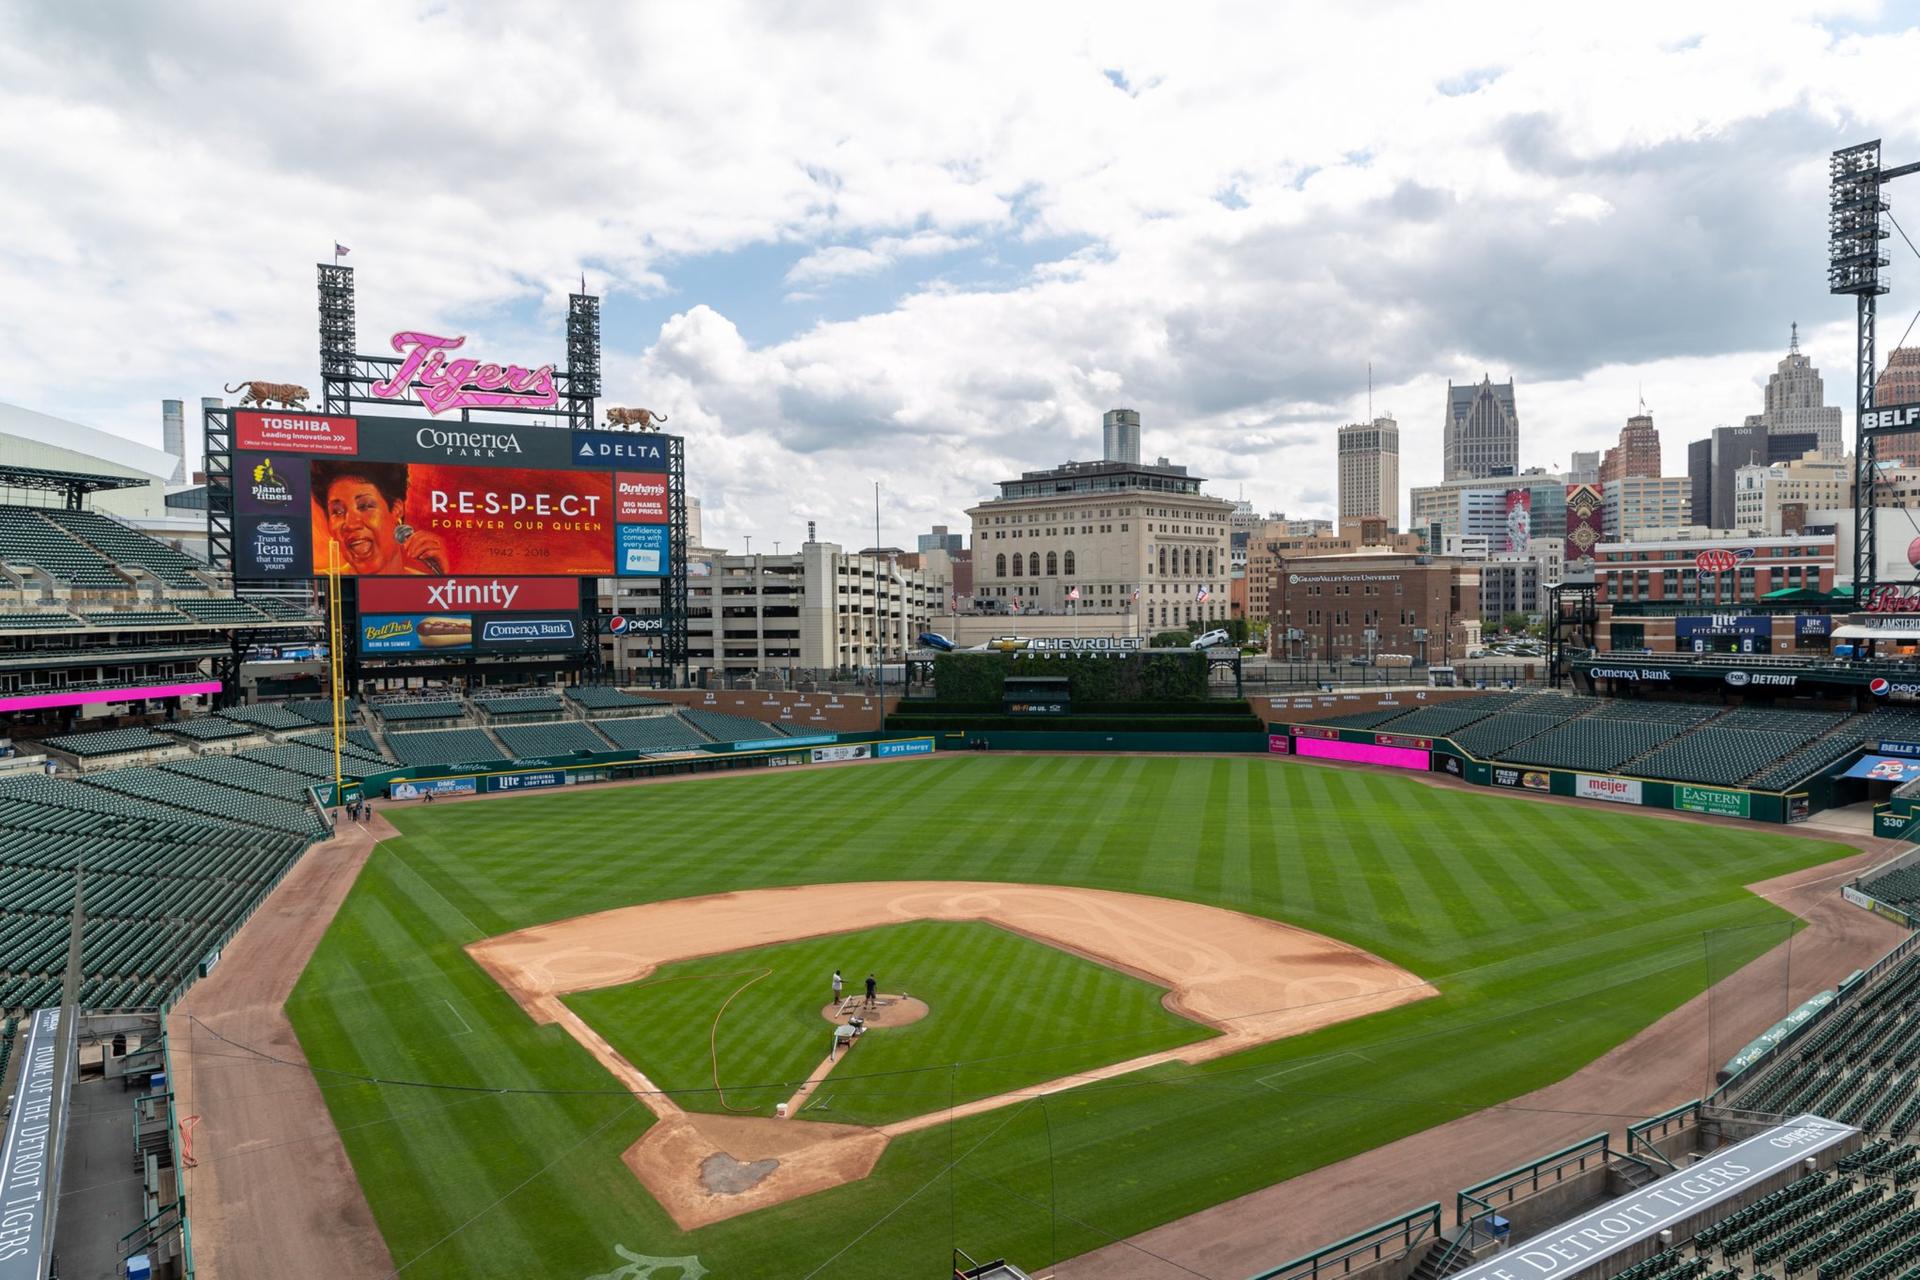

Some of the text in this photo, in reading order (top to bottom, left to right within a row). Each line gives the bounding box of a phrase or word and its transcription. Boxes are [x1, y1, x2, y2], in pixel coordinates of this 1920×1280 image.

[371, 331, 559, 412] Tigers
[1863, 407, 1920, 429] BELF
[261, 417, 331, 432] TOSHIBA
[262, 431, 331, 441] Leading Innovation
[446, 447, 495, 458] PARK
[600, 444, 660, 458] DELTA
[251, 485, 285, 494] planet
[619, 482, 664, 494] Dunham's
[256, 493, 293, 501] fitness
[431, 490, 600, 516] R-E-S-P-E-C-T
[432, 519, 601, 531] FOREVER OUR QUEEN
[622, 526, 662, 534] Confidence
[257, 535, 291, 543] Trust the
[254, 542, 294, 555] Team
[489, 548, 513, 557] 1942
[264, 563, 285, 571] yours
[1699, 551, 1734, 571] AAA
[427, 579, 520, 609] xfinity
[629, 617, 662, 632] pepsi
[1712, 614, 1737, 629] Lite
[1806, 619, 1822, 627] Lite
[1864, 618, 1881, 629] NEW
[365, 620, 413, 640] Ball Park
[541, 623, 567, 634] Bank
[1033, 637, 1144, 650] CHEVROLET
[1013, 652, 1126, 660] FOUNTAIN
[1641, 669, 1671, 680] Bank
[1730, 673, 1798, 686] FOX DETROIT
[1416, 692, 1426, 700] 42
[1881, 743, 1913, 753] BELLE
[1495, 769, 1519, 777] FRESH
[499, 776, 520, 789] Lite
[1589, 778, 1628, 794] meijer
[1682, 786, 1740, 805] EASTERN
[0, 1045, 55, 1261] HOME OF THE DETROIT TIGERS
[1516, 1160, 1751, 1273] DETROIT TIGERS
